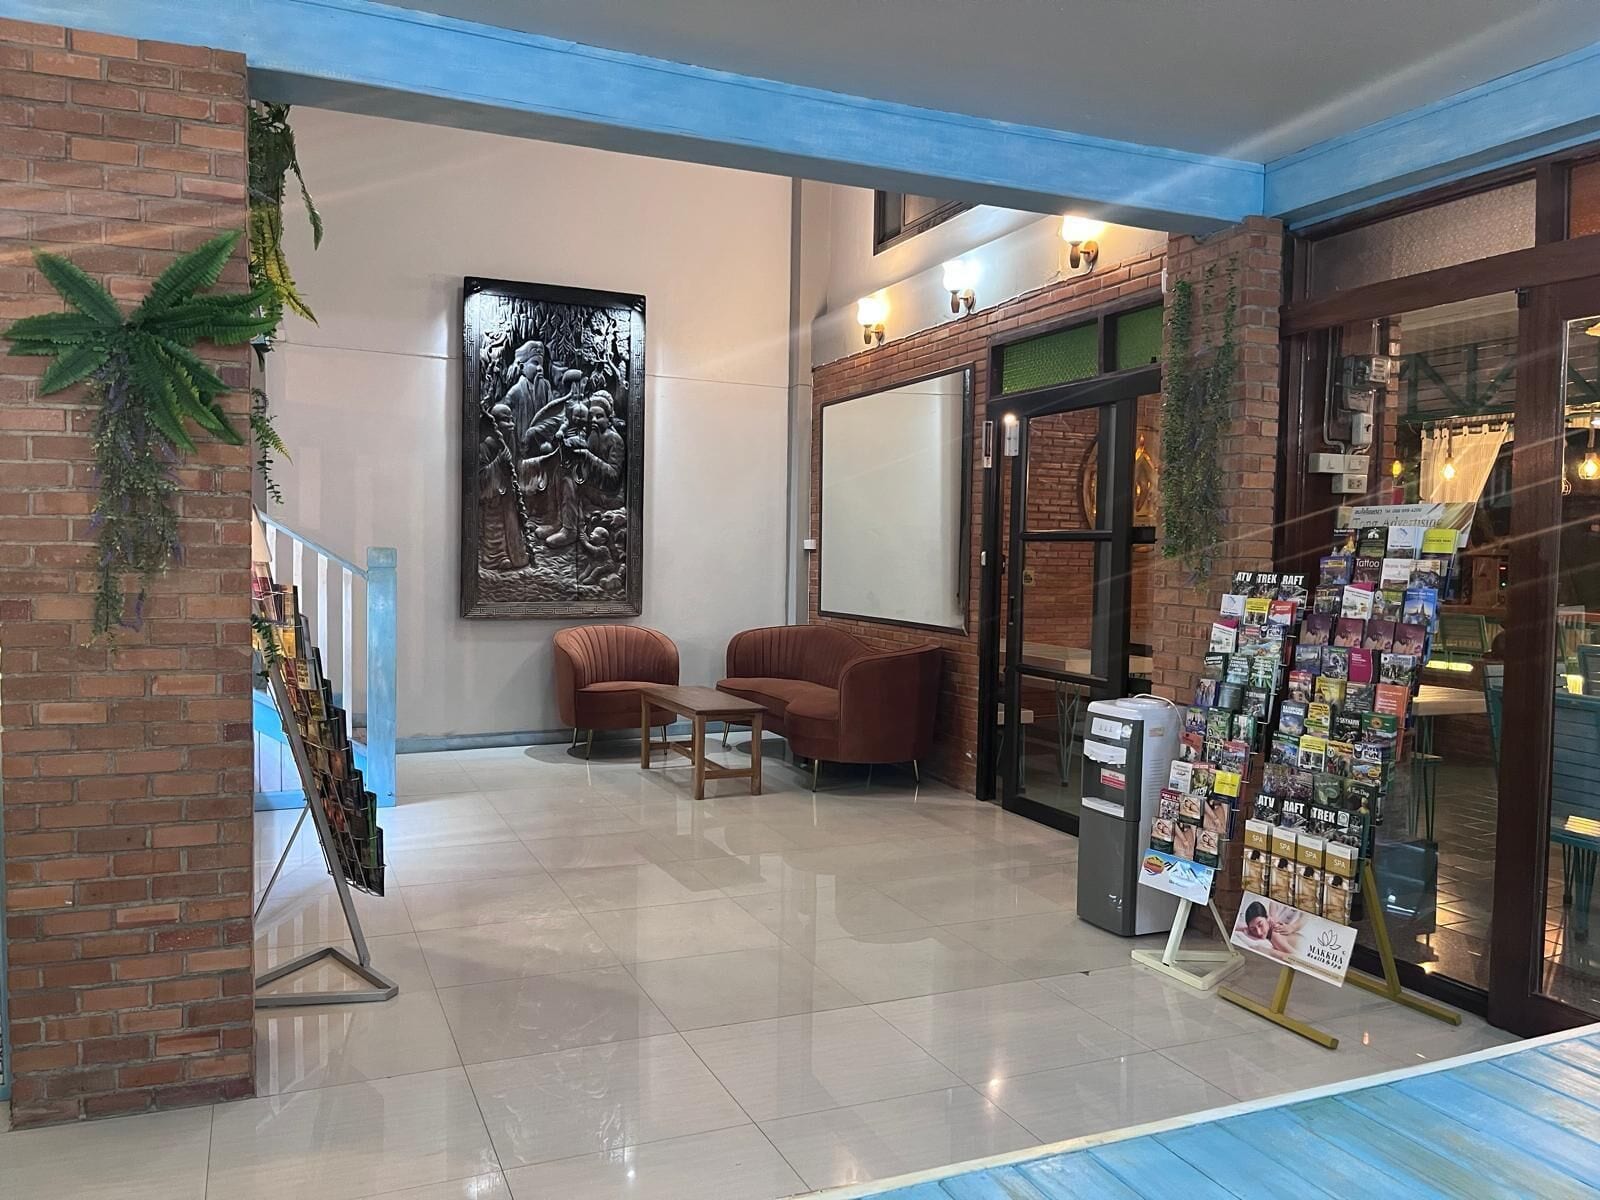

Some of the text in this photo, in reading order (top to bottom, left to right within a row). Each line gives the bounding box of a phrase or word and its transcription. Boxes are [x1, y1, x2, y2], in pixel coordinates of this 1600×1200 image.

[1356, 559, 1380, 568] Tattoo
[1236, 572, 1252, 581] ATV
[1257, 574, 1278, 584] TREK
[1281, 575, 1304, 585] RAFT
[1257, 794, 1275, 808] ATV
[1283, 800, 1305, 814] RAFT
[1313, 807, 1336, 823] TREK
[1252, 835, 1263, 843] SPA
[1279, 842, 1291, 851] SPA
[1305, 850, 1317, 859] SPA
[1333, 859, 1346, 869] SPA
[1309, 944, 1343, 965] MAKKHA
